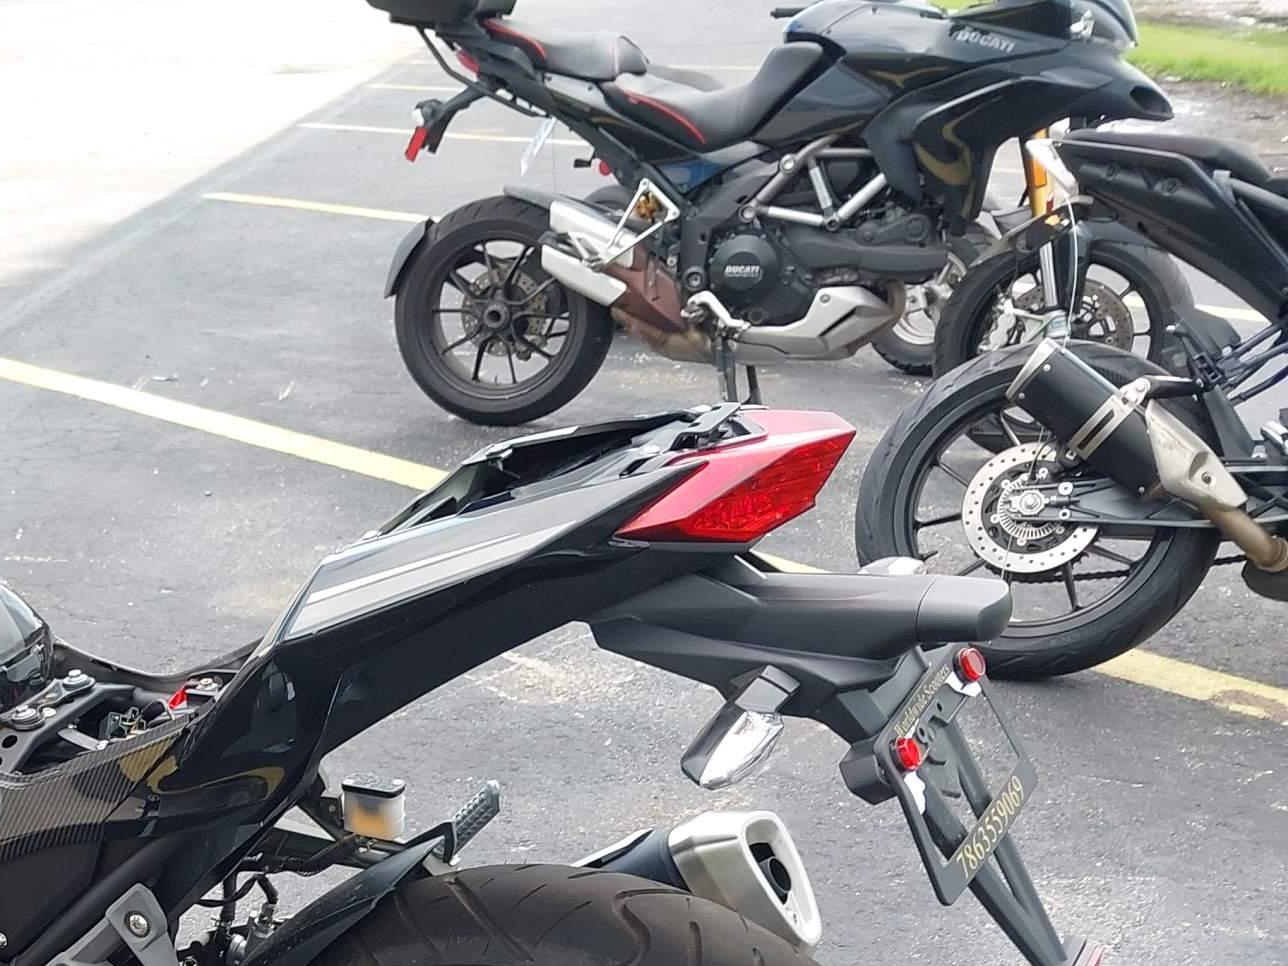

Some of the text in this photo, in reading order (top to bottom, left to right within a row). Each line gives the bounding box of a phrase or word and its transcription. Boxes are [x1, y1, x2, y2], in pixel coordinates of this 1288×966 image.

[955, 28, 1016, 53] DUCATI
[725, 265, 760, 273] DUCATI
[894, 664, 952, 737] Worldwide Scooters
[955, 774, 1025, 880] 7863559069
